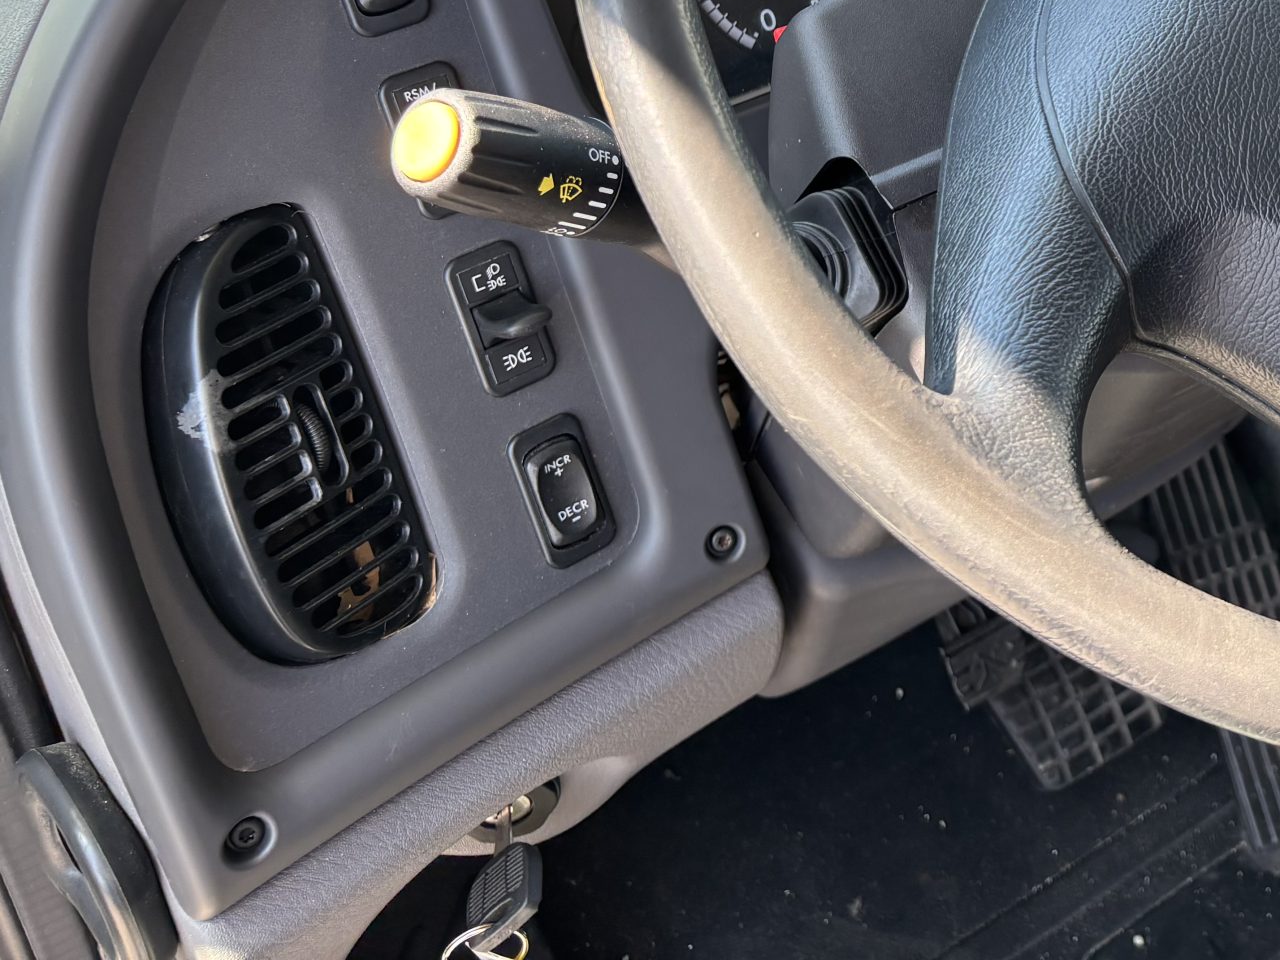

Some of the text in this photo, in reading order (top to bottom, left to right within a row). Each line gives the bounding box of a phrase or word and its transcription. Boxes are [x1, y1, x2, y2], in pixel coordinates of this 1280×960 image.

[760, 8, 777, 32] 0
[588, 147, 611, 165] OFF
[544, 453, 572, 474] INCR
[557, 498, 589, 522] DECR
